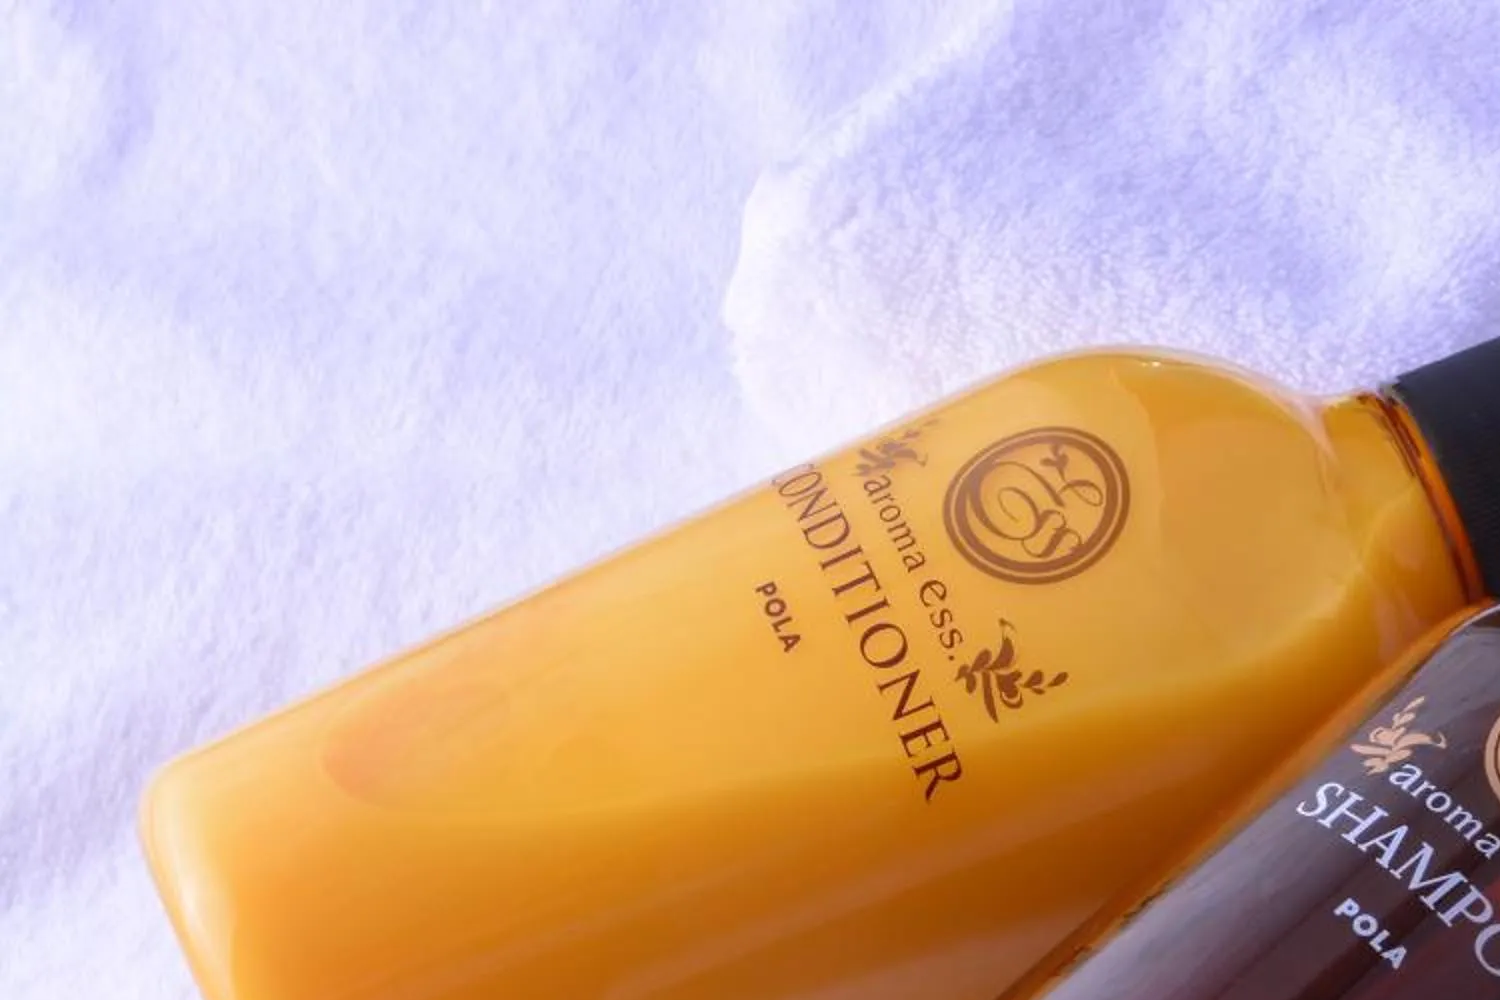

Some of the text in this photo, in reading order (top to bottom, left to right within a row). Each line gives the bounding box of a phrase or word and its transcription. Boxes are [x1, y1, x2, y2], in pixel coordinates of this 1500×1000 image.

[863, 474, 963, 661] aroma ess.
[755, 582, 801, 652] POLA
[1333, 898, 1407, 969] POLA
